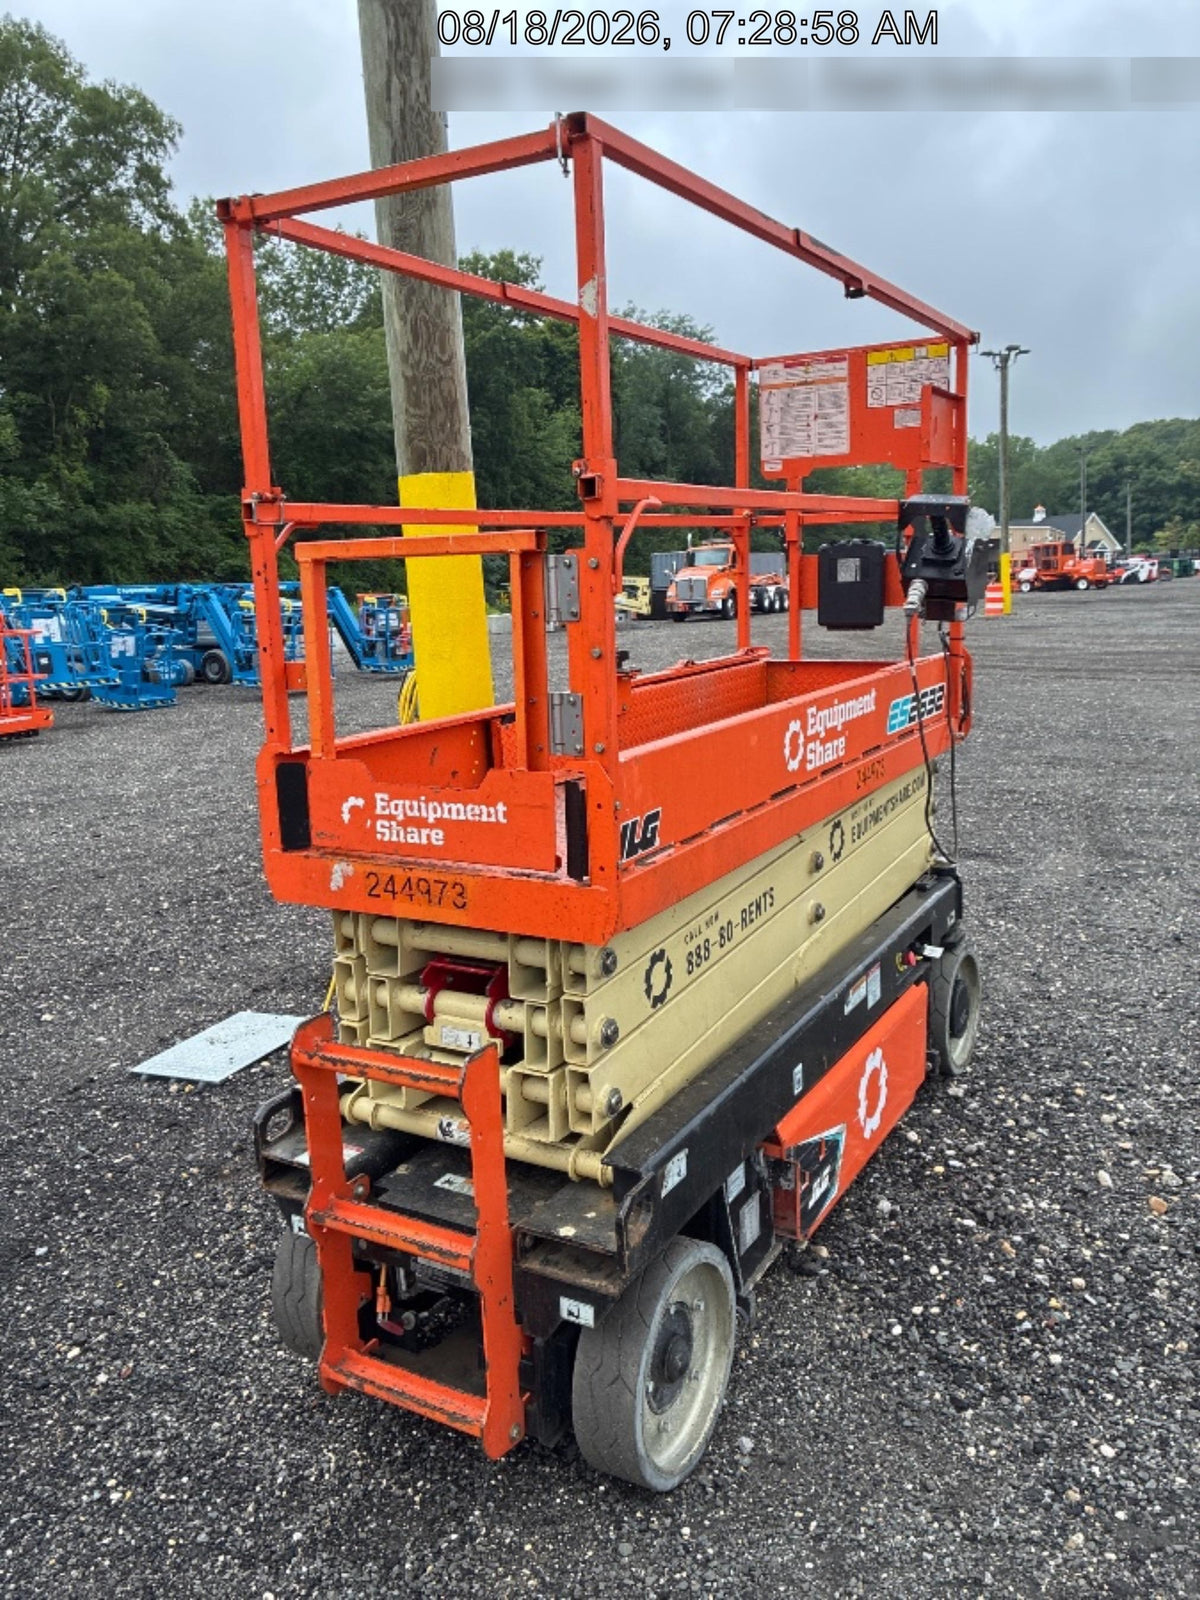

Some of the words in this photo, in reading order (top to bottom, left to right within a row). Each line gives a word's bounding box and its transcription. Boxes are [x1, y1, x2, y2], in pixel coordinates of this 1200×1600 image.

[806, 687, 877, 738] Equipment
[806, 735, 846, 771] Share
[374, 792, 508, 824] Equipment
[375, 818, 445, 846] Share
[365, 871, 468, 910] 244973
[685, 886, 775, 977] 888-80-RENTS
